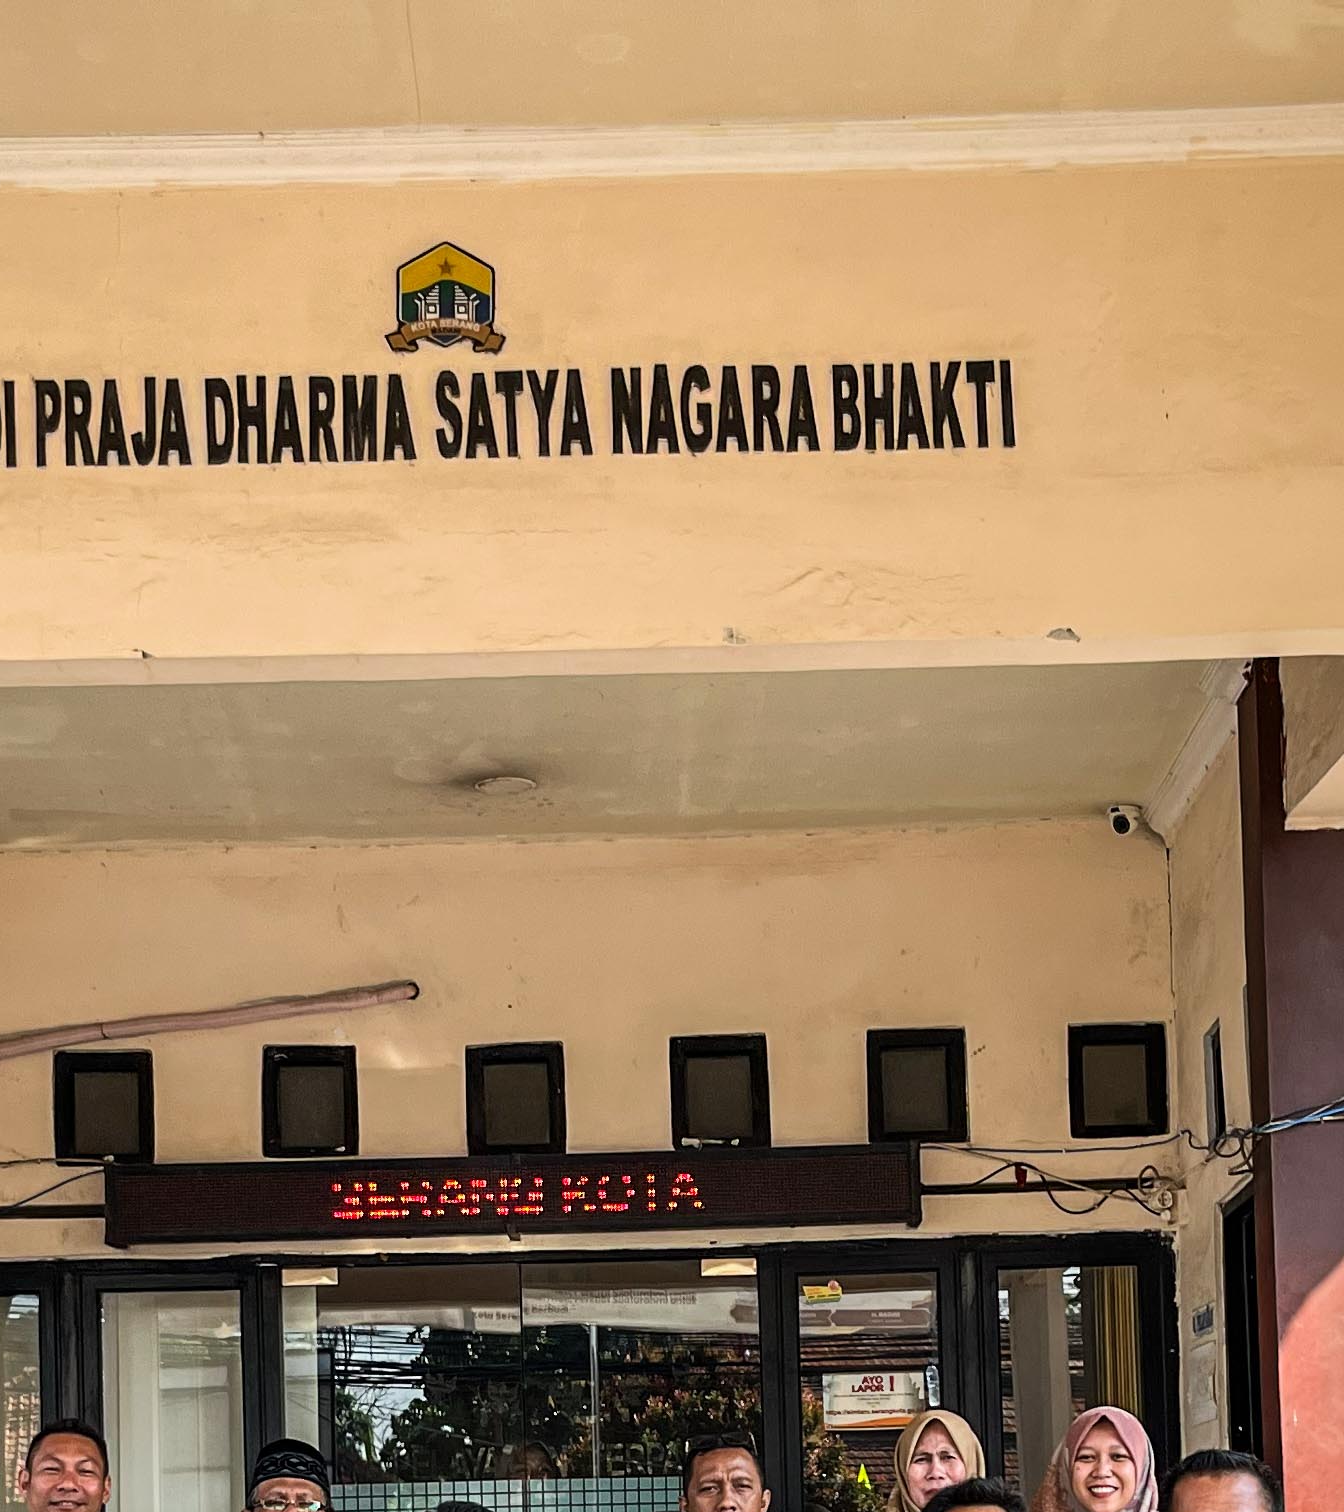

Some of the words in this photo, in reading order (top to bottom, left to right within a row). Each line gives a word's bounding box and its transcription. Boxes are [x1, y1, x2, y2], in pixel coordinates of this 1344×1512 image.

[34, 376, 192, 467] PRAJA
[204, 374, 417, 465] DHARMA
[435, 369, 593, 459] SATYA
[611, 363, 820, 455] NAGARA
[833, 359, 1016, 452] BHAKTI
[862, 1376, 883, 1384] AYO
